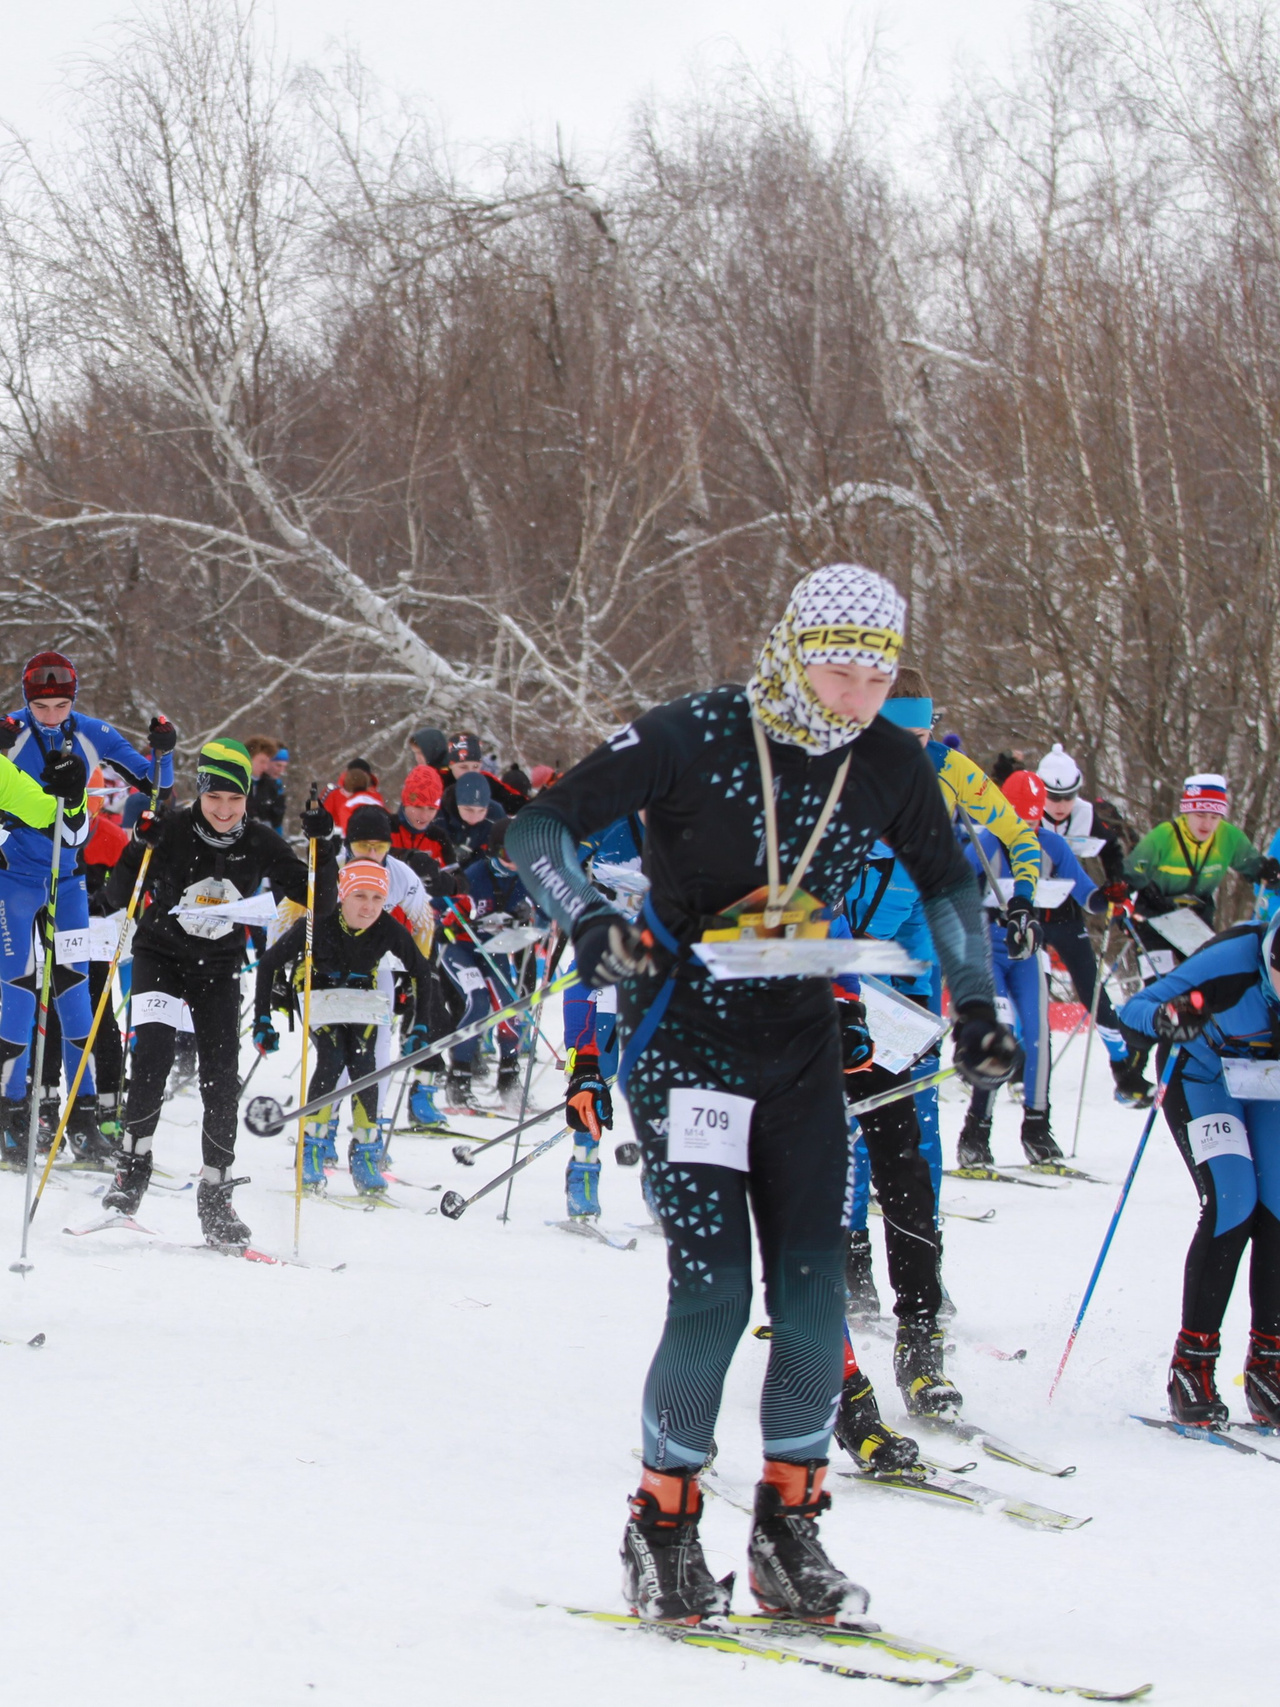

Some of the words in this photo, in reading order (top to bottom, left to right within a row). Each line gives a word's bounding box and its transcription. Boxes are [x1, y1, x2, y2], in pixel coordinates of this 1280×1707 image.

[65, 937, 83, 948] 747
[147, 998, 168, 1008] 727
[692, 1107, 729, 1130] 709
[1202, 1122, 1231, 1137] 716
[655, 1409, 670, 1469] VICTORY
[637, 1622, 688, 1641] FISCHER
[770, 1621, 826, 1637] FISCHER
